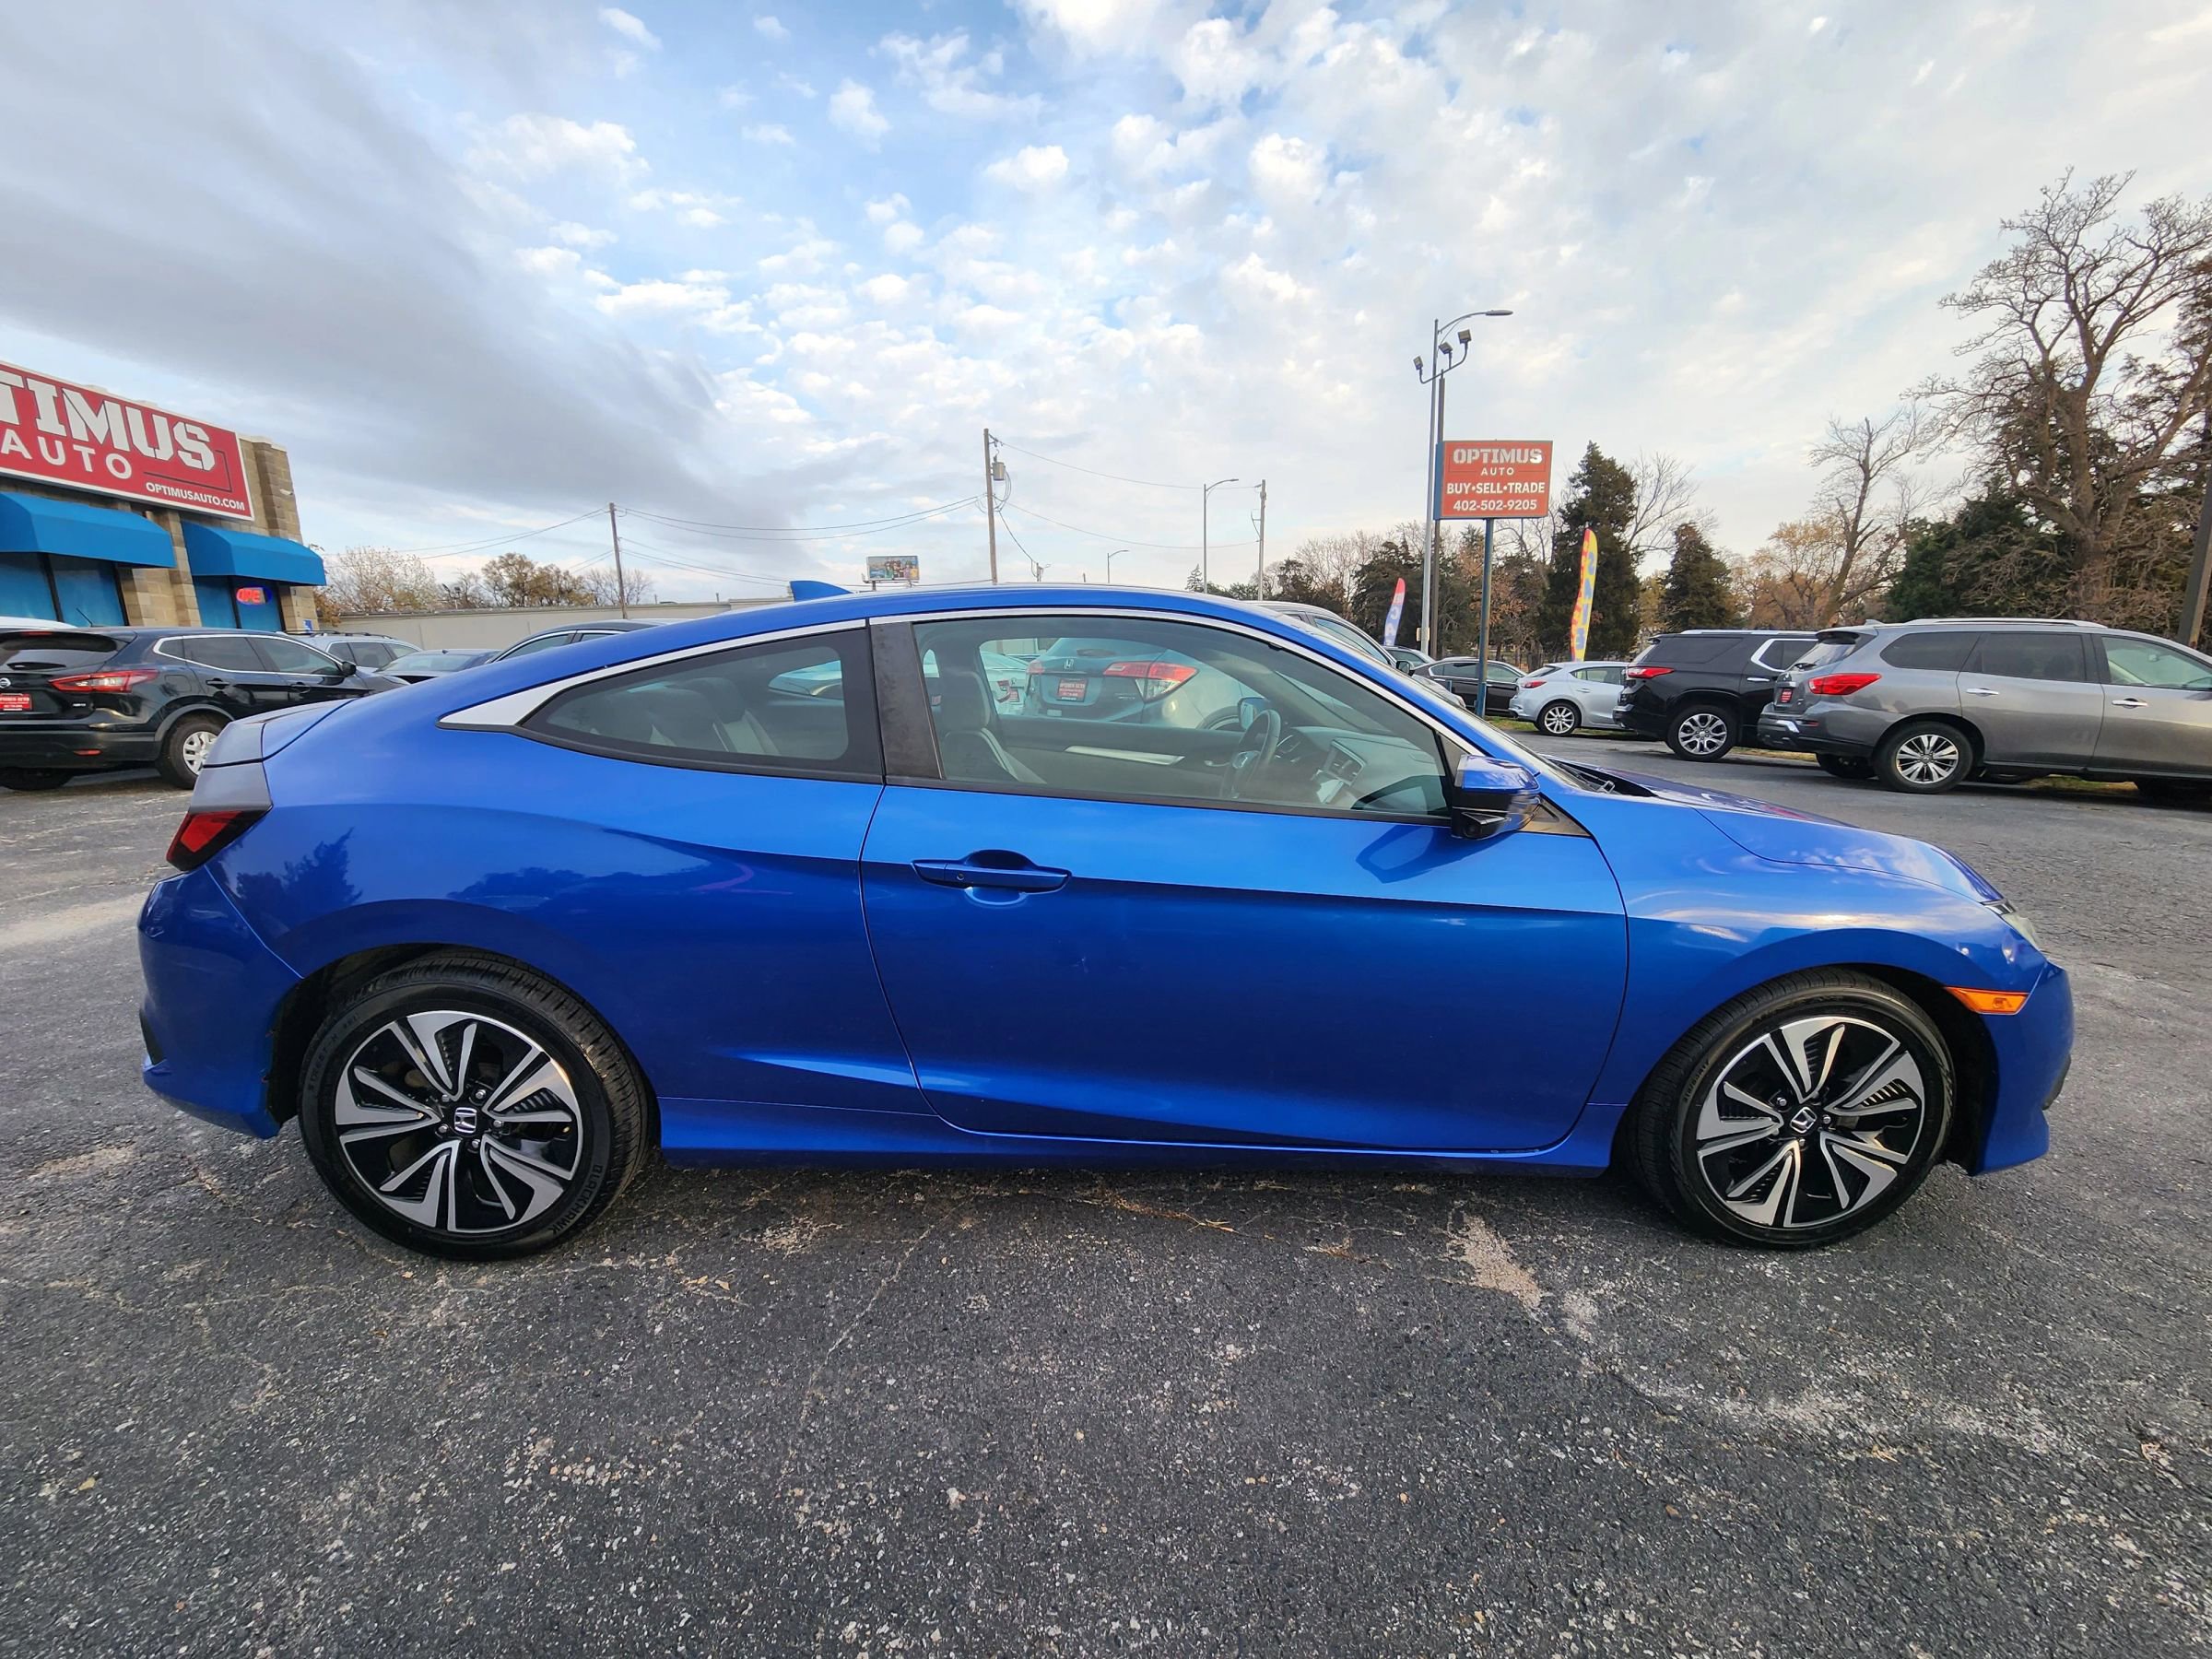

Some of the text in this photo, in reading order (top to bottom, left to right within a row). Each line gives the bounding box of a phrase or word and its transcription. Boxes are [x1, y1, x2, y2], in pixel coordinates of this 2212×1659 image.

[1, 429, 132, 479] AUTO
[1453, 448, 1542, 464] OPTIMUS
[1480, 467, 1514, 476] AUTO
[146, 482, 245, 511] OPTIMUSAUTO.COM
[1453, 500, 1537, 511] 402-502-9205
[547, 1164, 603, 1234] BLACKHAWK
